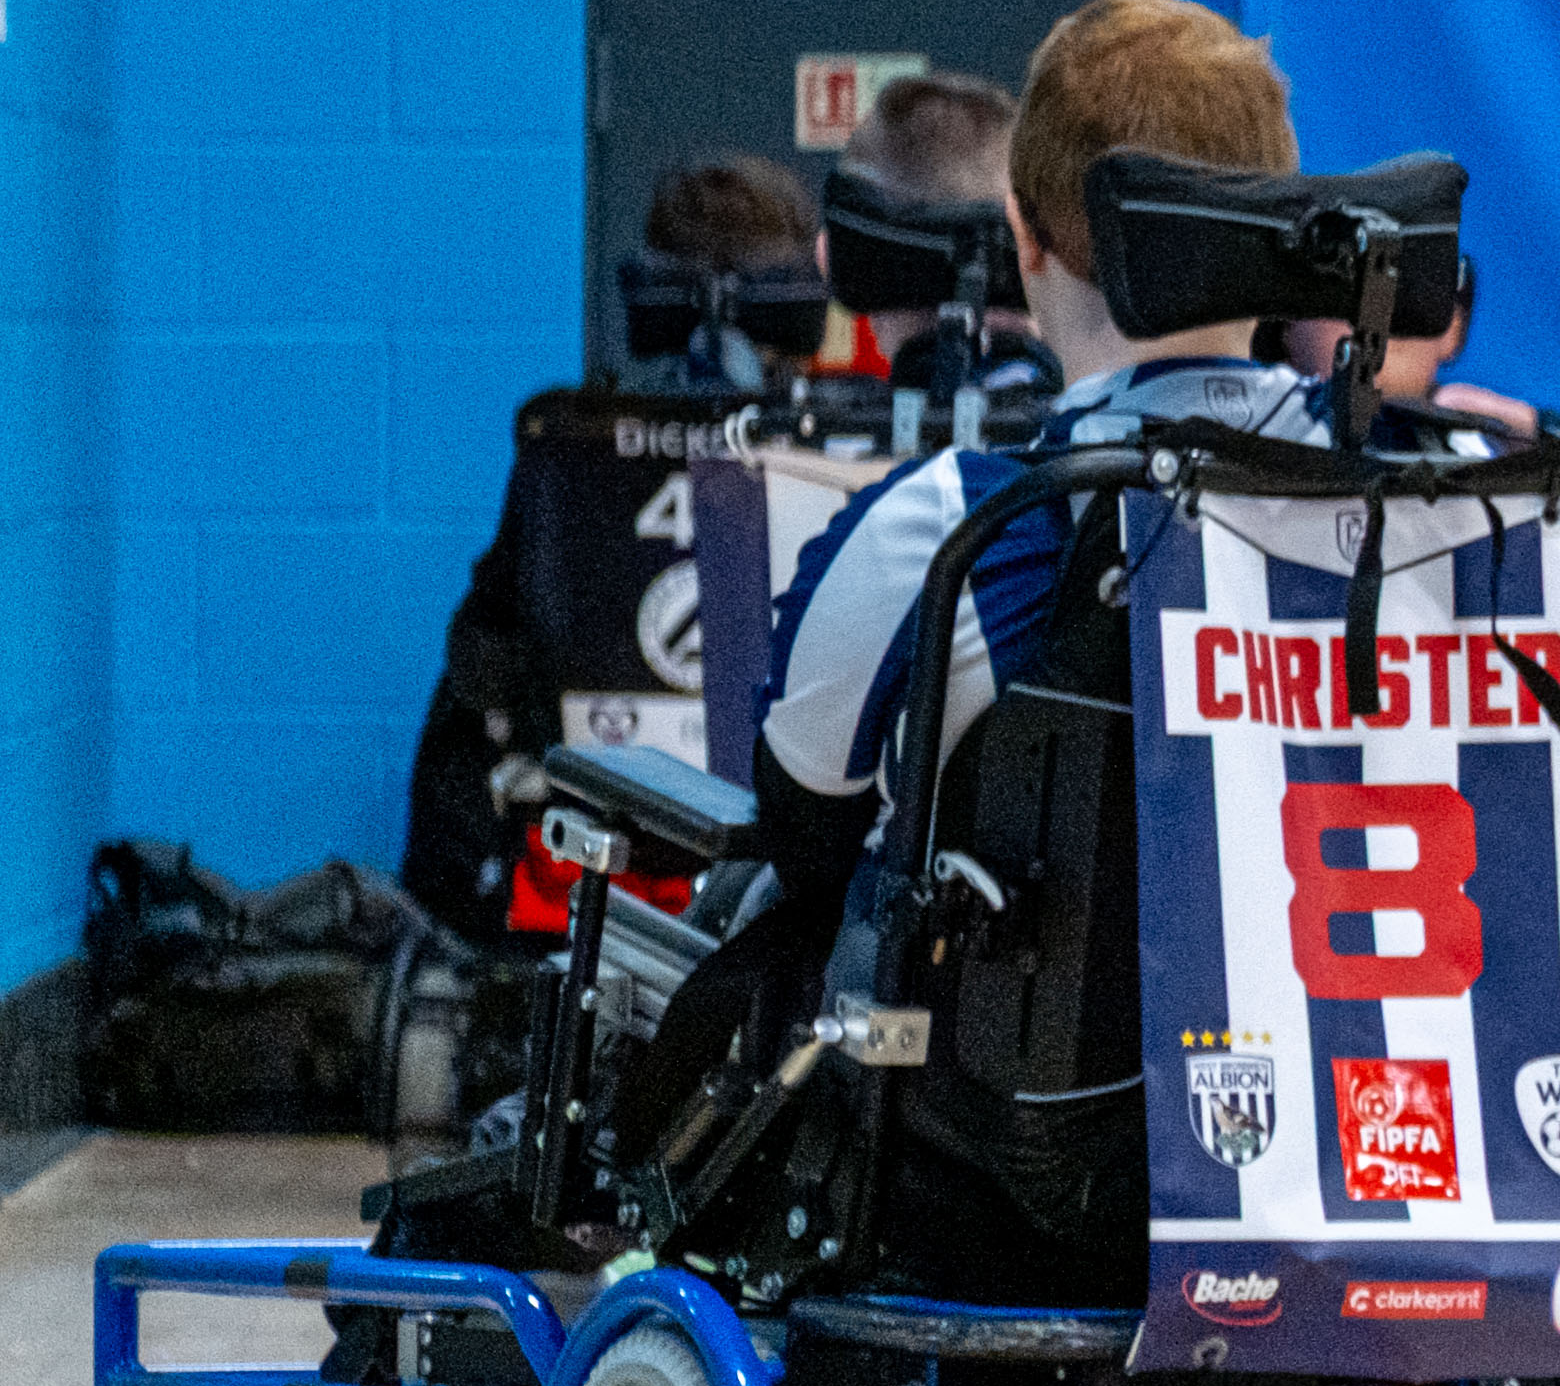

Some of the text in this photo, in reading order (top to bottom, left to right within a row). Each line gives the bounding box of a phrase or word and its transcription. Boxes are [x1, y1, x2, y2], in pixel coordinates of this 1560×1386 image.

[1279, 782, 1483, 999] 8
[1194, 1072, 1269, 1089] ALBION
[1359, 1126, 1442, 1155] FIPFA
[1194, 1270, 1279, 1304] Bache
[1375, 1286, 1481, 1311] clarkeprint
